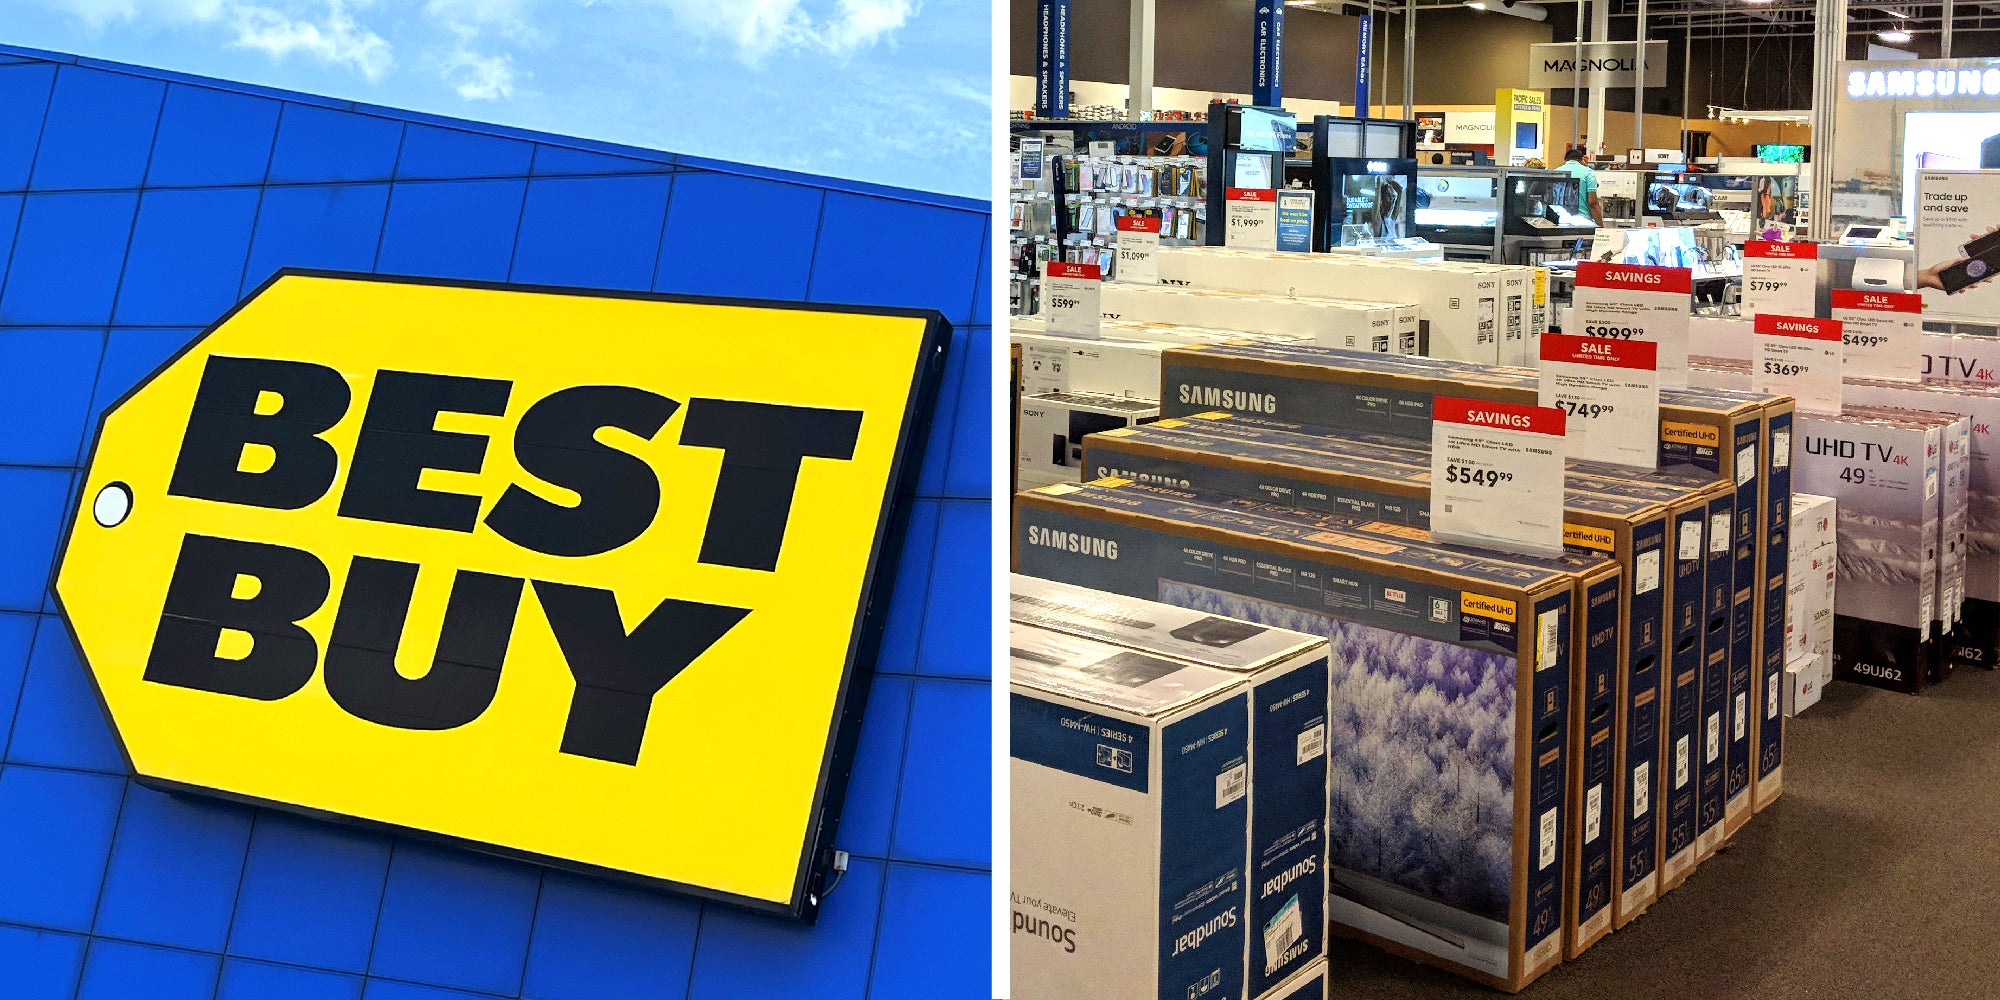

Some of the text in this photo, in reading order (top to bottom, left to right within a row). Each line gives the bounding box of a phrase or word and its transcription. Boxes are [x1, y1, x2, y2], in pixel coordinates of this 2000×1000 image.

[1259, 38, 1267, 87] ELECTRONICS
[1848, 67, 2000, 98] SAMSUNG
[1528, 95, 1542, 105] SALES
[1924, 192, 1968, 203] Trade up
[1923, 204, 1969, 213] and save
[1770, 244, 1791, 252] SALE
[1066, 265, 1082, 273] SALE
[1506, 279, 1523, 287] SONY
[1605, 271, 1661, 284] SAVINGS
[1477, 281, 1496, 289] SONY
[1863, 295, 1888, 304] SALE
[1371, 319, 1389, 327] SONY
[1399, 315, 1416, 324] SONY
[1776, 321, 1819, 334] SAVINGS
[1581, 342, 1612, 355] SALE
[1938, 355, 1977, 378] TV
[1976, 368, 1994, 381] 4K
[1179, 383, 1276, 414] SAMSUNG
[1023, 409, 1044, 418] SONY
[1467, 409, 1531, 428] SAVINGS
[1664, 427, 1716, 441] Certified UHD
[1973, 423, 1990, 435] 4K
[1805, 435, 1909, 467] UHD TV 4K
[168, 355, 863, 571] BEST
[1839, 466, 1865, 484] 49
[1028, 525, 1118, 560] SAMSUNG
[1594, 534, 1612, 545] UHD
[1463, 598, 1514, 616] Certified UHD
[142, 533, 754, 766] BUY
[1853, 661, 1902, 682] 49UJ62
[1060, 717, 1134, 744] 4 SERIES HW-M450
[1260, 854, 1317, 900] Soundbar
[1022, 896, 1042, 910] your
[1043, 902, 1076, 923] Elevate
[1013, 910, 1076, 954] Sound
[1172, 905, 1237, 957] Soundbar
